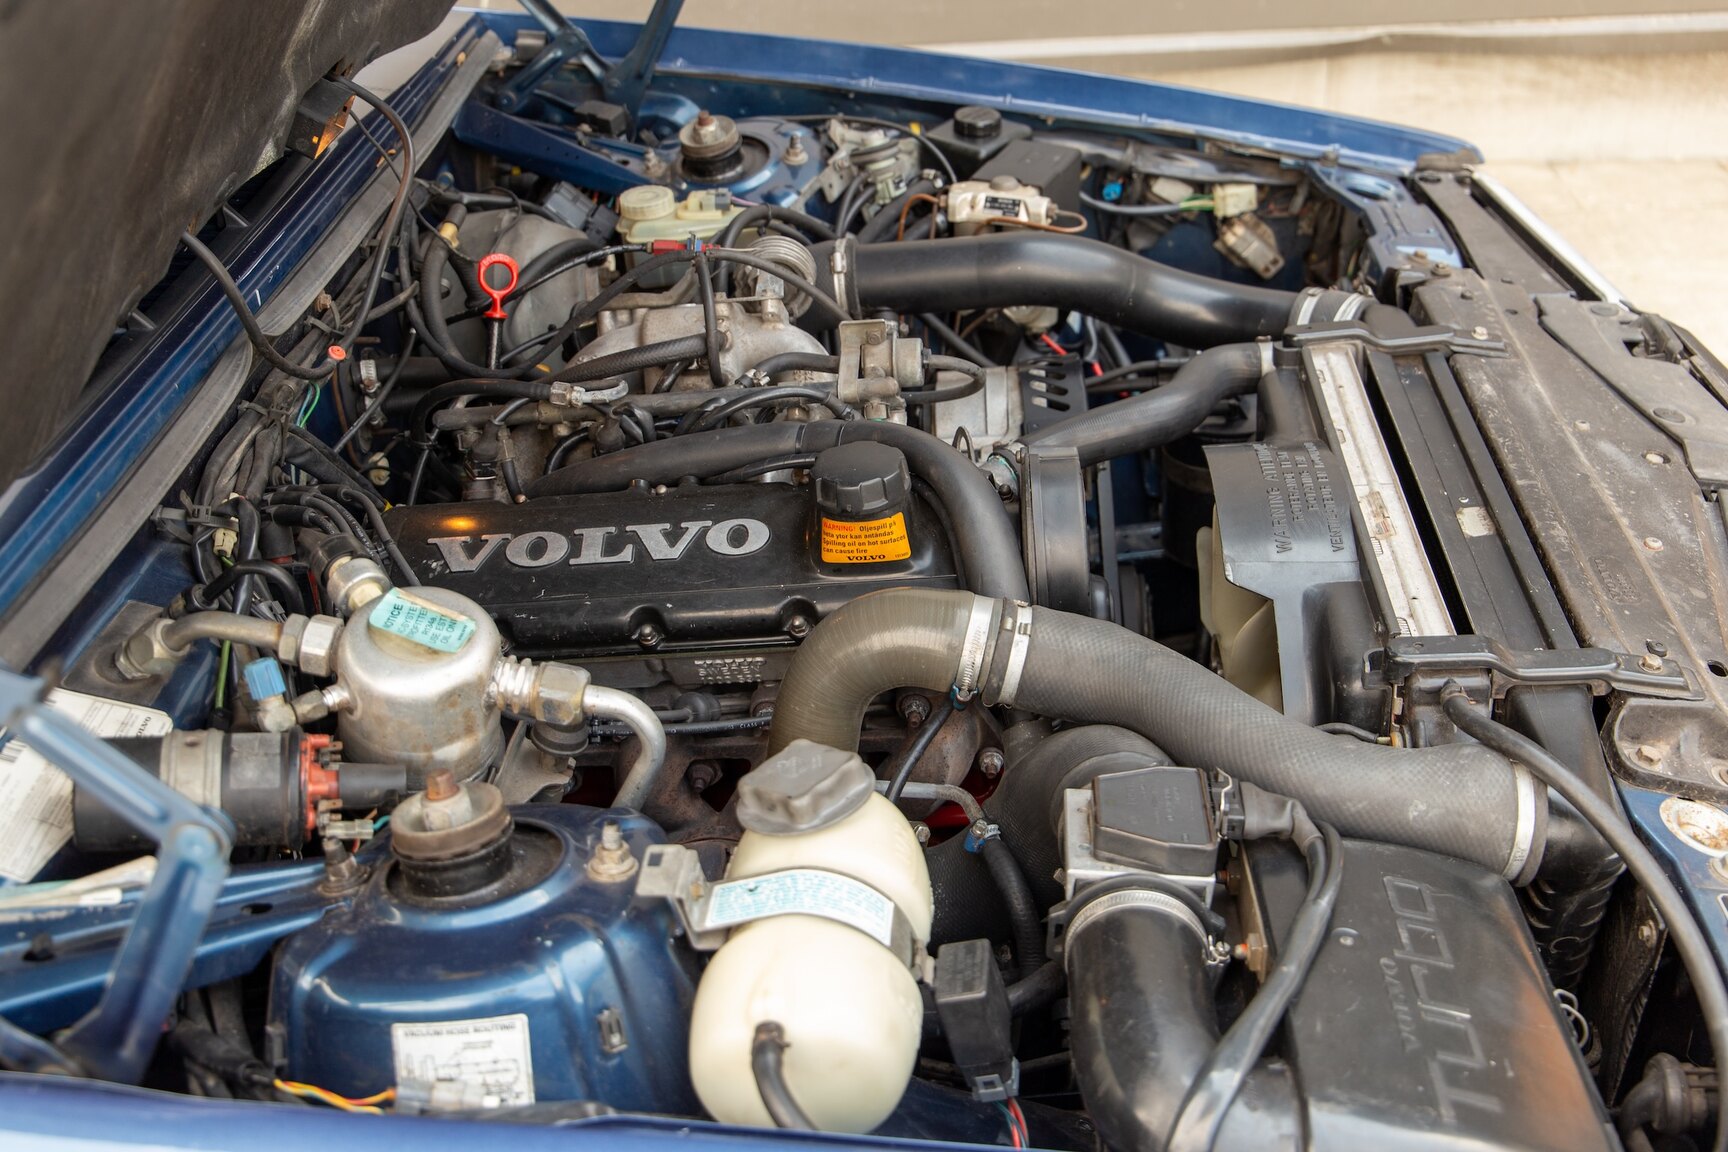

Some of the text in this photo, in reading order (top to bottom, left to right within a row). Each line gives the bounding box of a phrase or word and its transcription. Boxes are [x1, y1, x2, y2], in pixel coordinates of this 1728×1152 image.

[1299, 470, 1320, 511] ROTATING
[427, 518, 771, 573] VOLVO
[823, 521, 856, 532] WARNING!
[859, 523, 888, 533] Oljespill
[823, 538, 846, 547] Spilling
[880, 535, 906, 545] surfaces
[1266, 487, 1293, 554] WARNING
[1320, 485, 1344, 552] VENTILATEUR
[1379, 957, 1421, 1053] VOLVO
